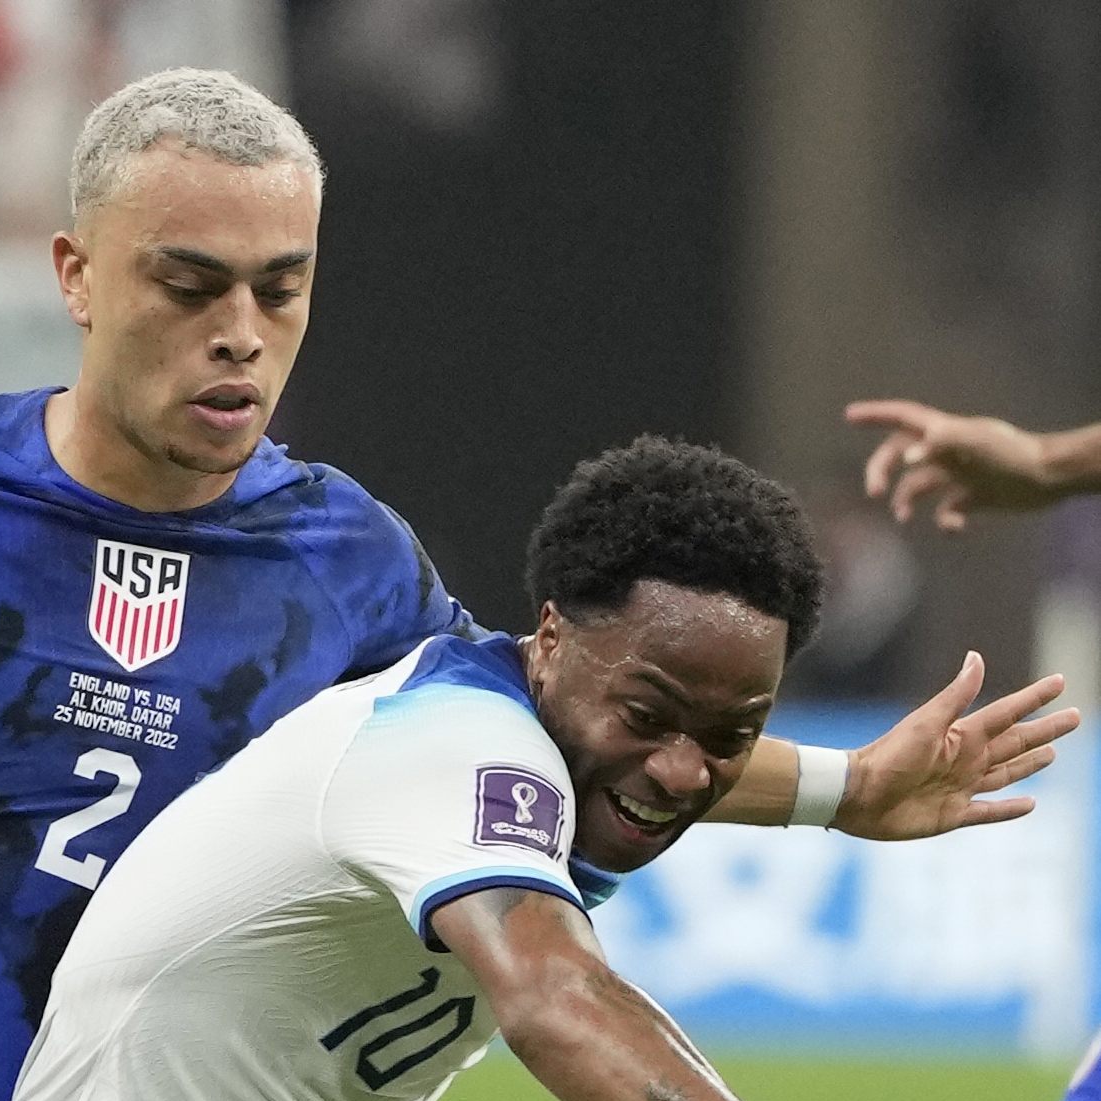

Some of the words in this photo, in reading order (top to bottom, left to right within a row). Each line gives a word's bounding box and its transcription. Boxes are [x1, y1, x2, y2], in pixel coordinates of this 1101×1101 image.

[102, 546, 182, 599] USA
[69, 671, 131, 701] ENGLAND
[134, 688, 152, 707] VS.
[155, 693, 181, 715] USA
[69, 690, 87, 709] AL
[90, 695, 128, 720] KHOR,
[131, 706, 173, 730] QATAR
[53, 704, 73, 723] 25
[73, 710, 143, 741] NOVEMBER
[144, 728, 179, 750] 2022
[34, 747, 142, 891] 2
[319, 966, 476, 1092] 10
